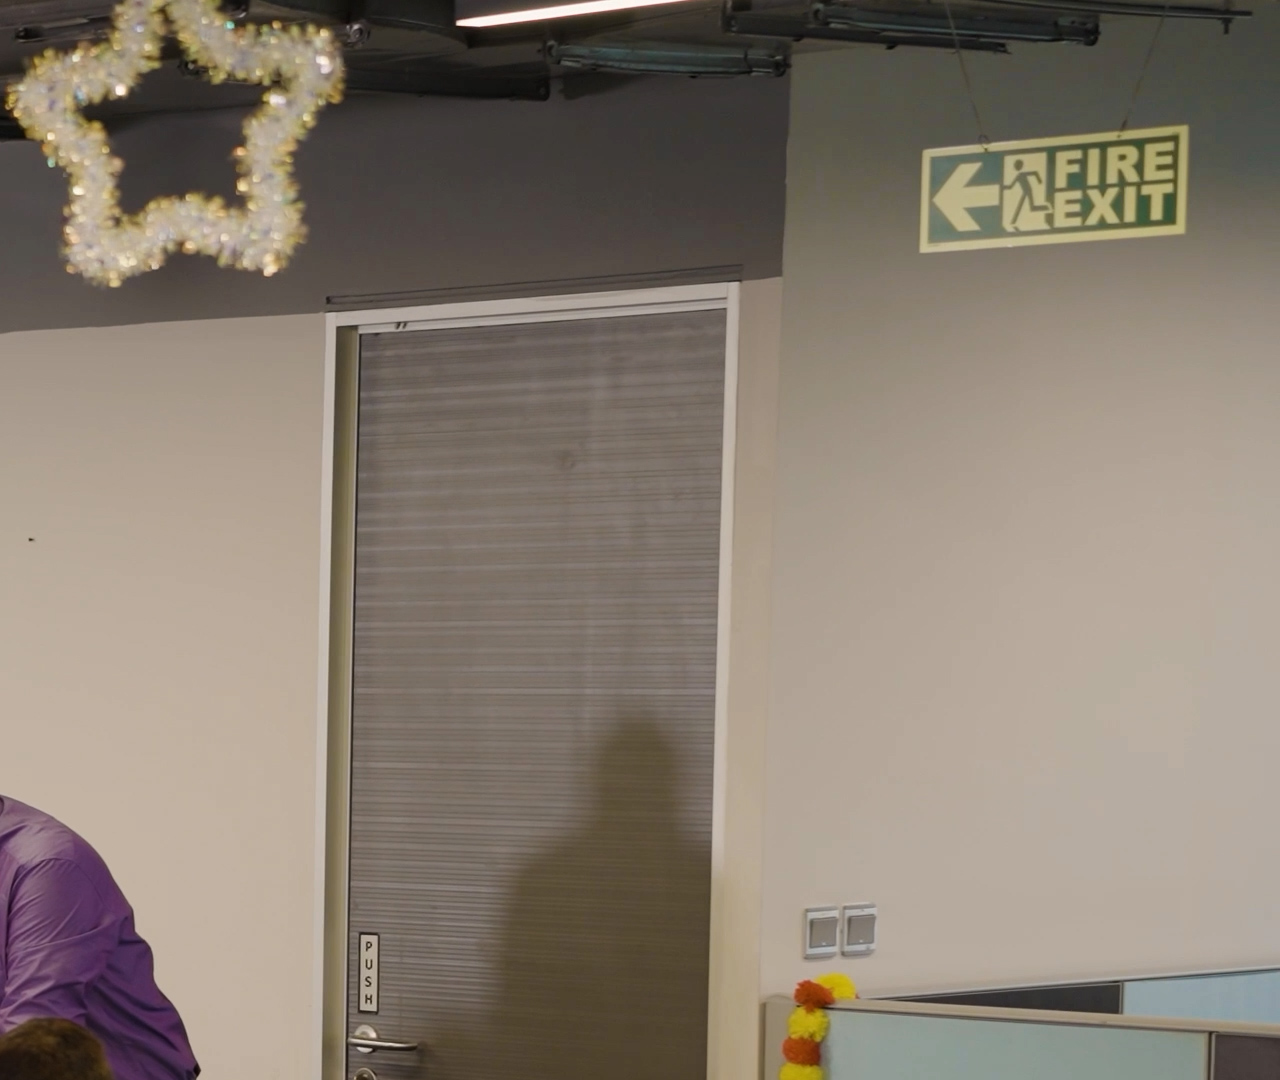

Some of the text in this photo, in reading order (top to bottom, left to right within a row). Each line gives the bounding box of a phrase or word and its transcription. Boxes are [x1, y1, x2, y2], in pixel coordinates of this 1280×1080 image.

[1055, 141, 1175, 189] FIRE
[1053, 182, 1174, 228] EXIT
[364, 941, 373, 1005] PUSH
